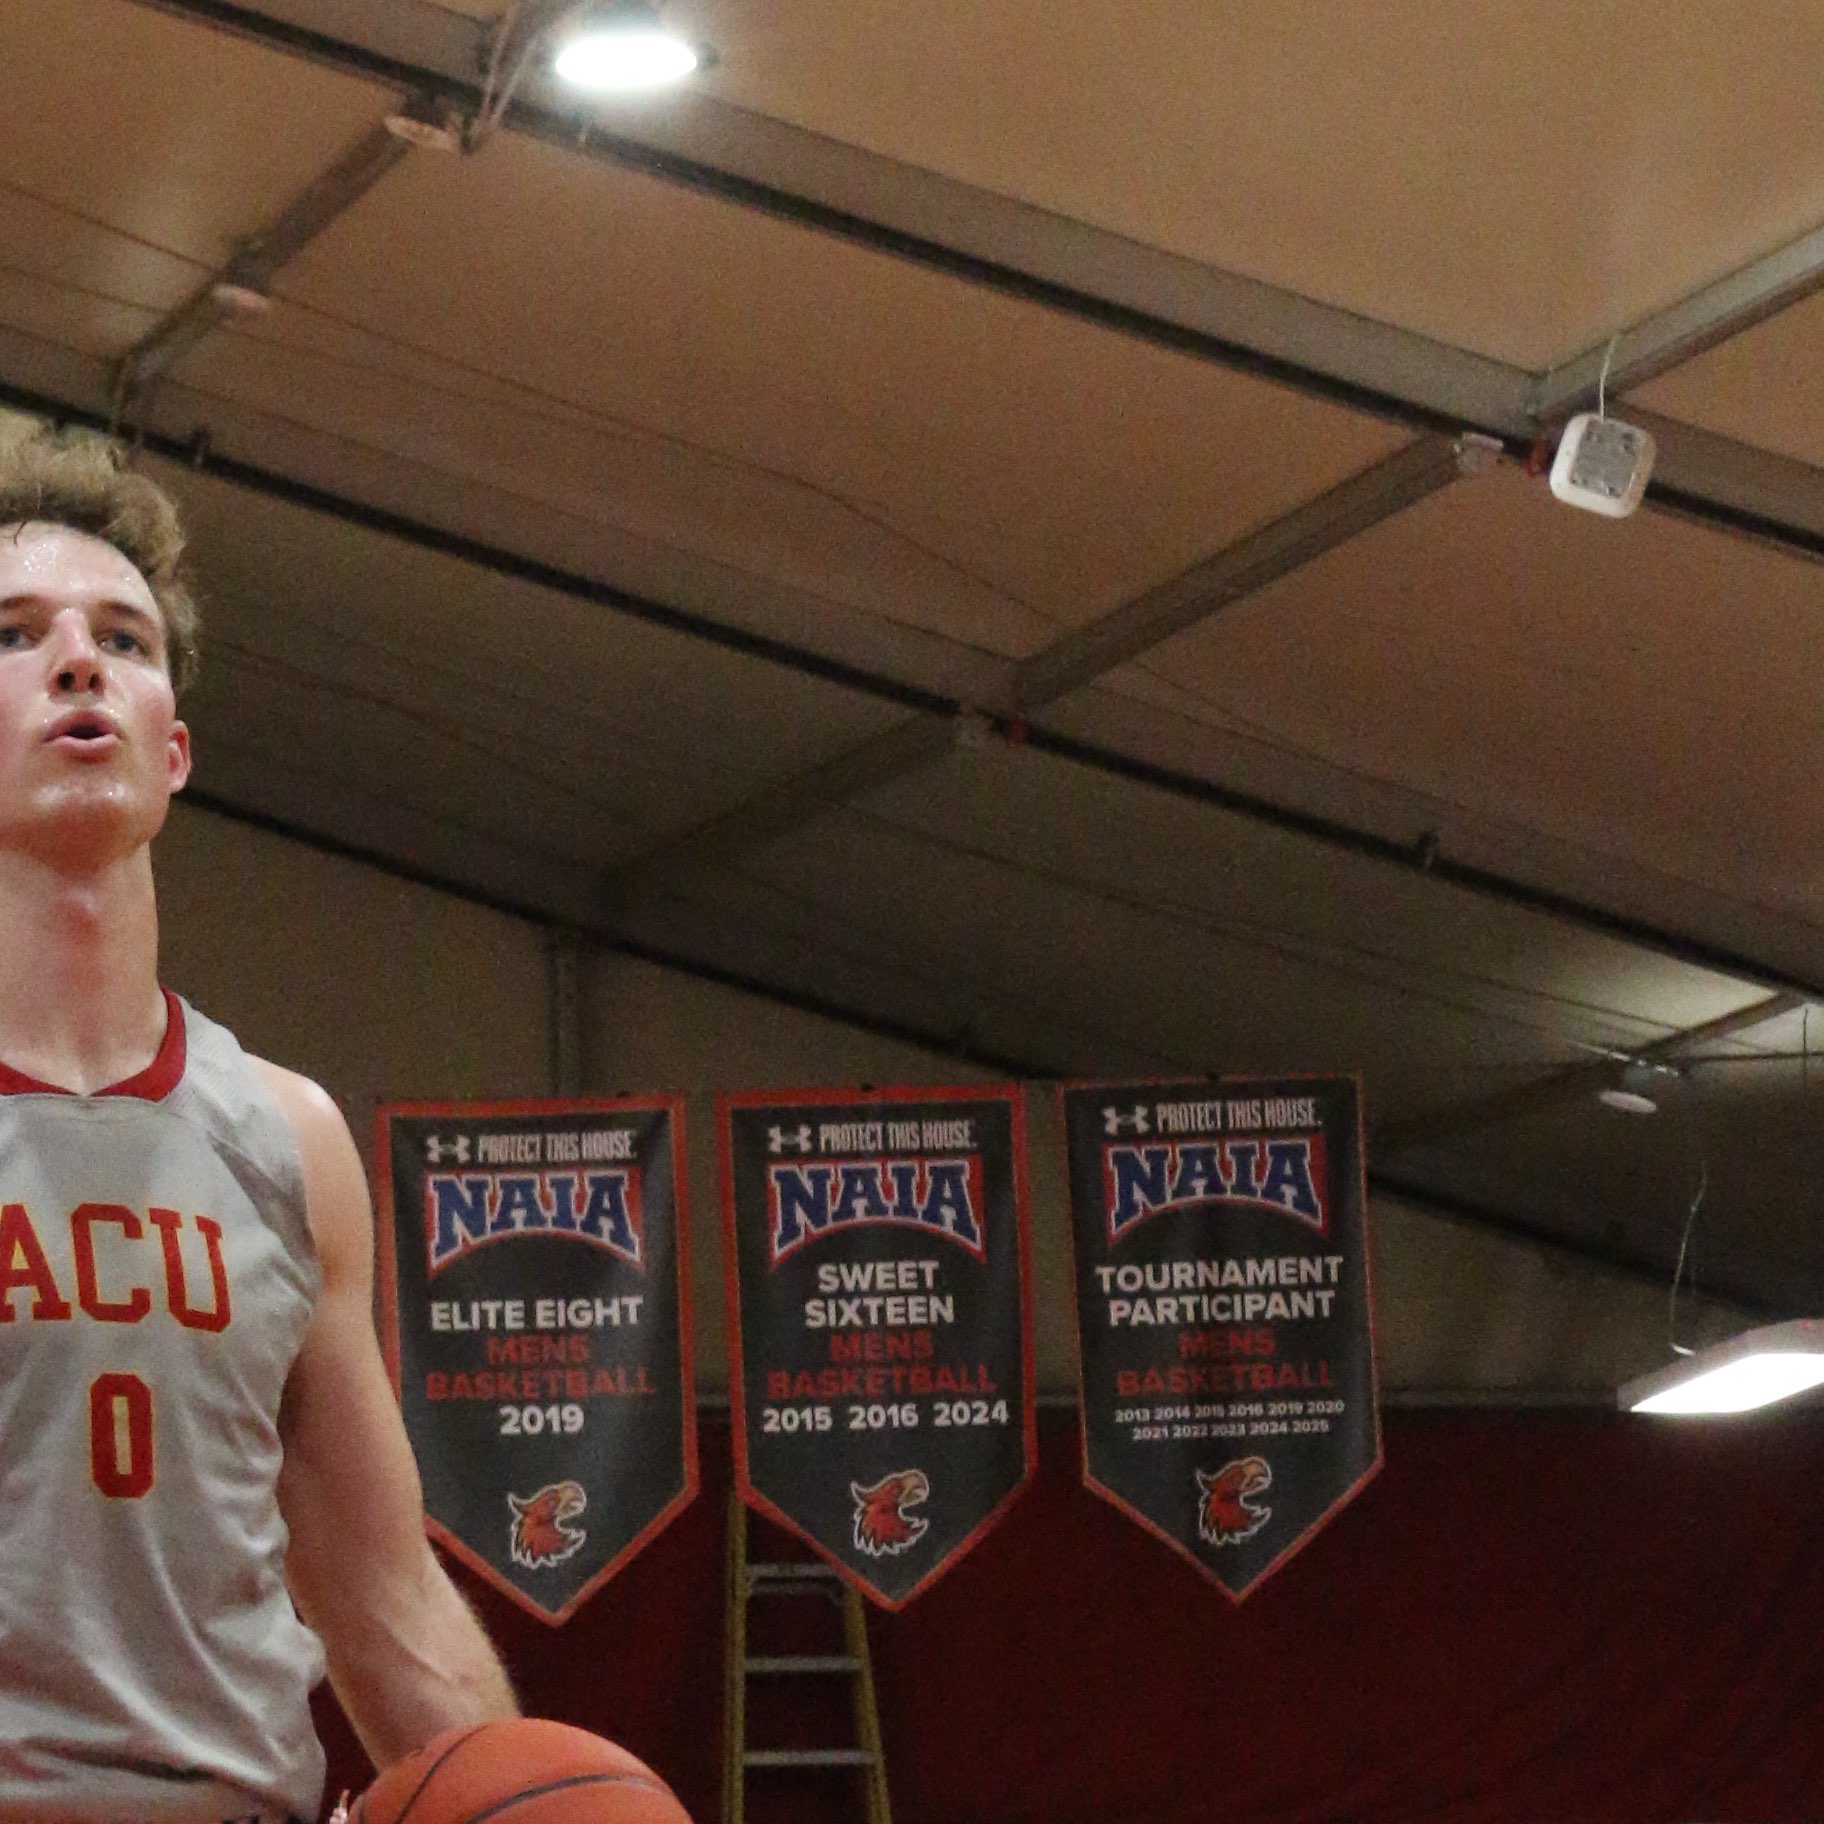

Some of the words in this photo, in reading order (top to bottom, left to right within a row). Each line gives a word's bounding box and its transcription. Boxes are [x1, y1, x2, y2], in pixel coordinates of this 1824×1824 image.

[1156, 1102, 1222, 1132] PROTECT
[1229, 1101, 1262, 1128] THIS
[478, 1133, 541, 1163] PROTECT
[547, 1132, 579, 1161] THIS
[820, 1122, 883, 1151] PROTECT
[888, 1120, 920, 1149] THIS
[1107, 1139, 1323, 1236] NAIA
[429, 1171, 641, 1269] NAIA
[770, 1159, 983, 1259] NAIA
[817, 1260, 939, 1293] SWEET
[1095, 1256, 1344, 1295] TOURNAMENT
[431, 1300, 525, 1331] ELITE
[536, 1296, 644, 1329] EIGHT
[804, 1295, 955, 1328] SIXTEEN
[1109, 1290, 1336, 1327] PARTICIPANT
[486, 1333, 591, 1365] MENS
[830, 1329, 934, 1361] MENS
[1178, 1327, 1276, 1359] MENS
[426, 1366, 657, 1399] BASKETBALL
[767, 1364, 998, 1399] BASKETBALL
[1115, 1360, 1334, 1397] BASKETBALL
[498, 1403, 585, 1435] 2019
[762, 1405, 833, 1433] 2015
[848, 1403, 919, 1430] 2016
[933, 1399, 1010, 1427] 2024
[90, 1372, 154, 1499] 0
